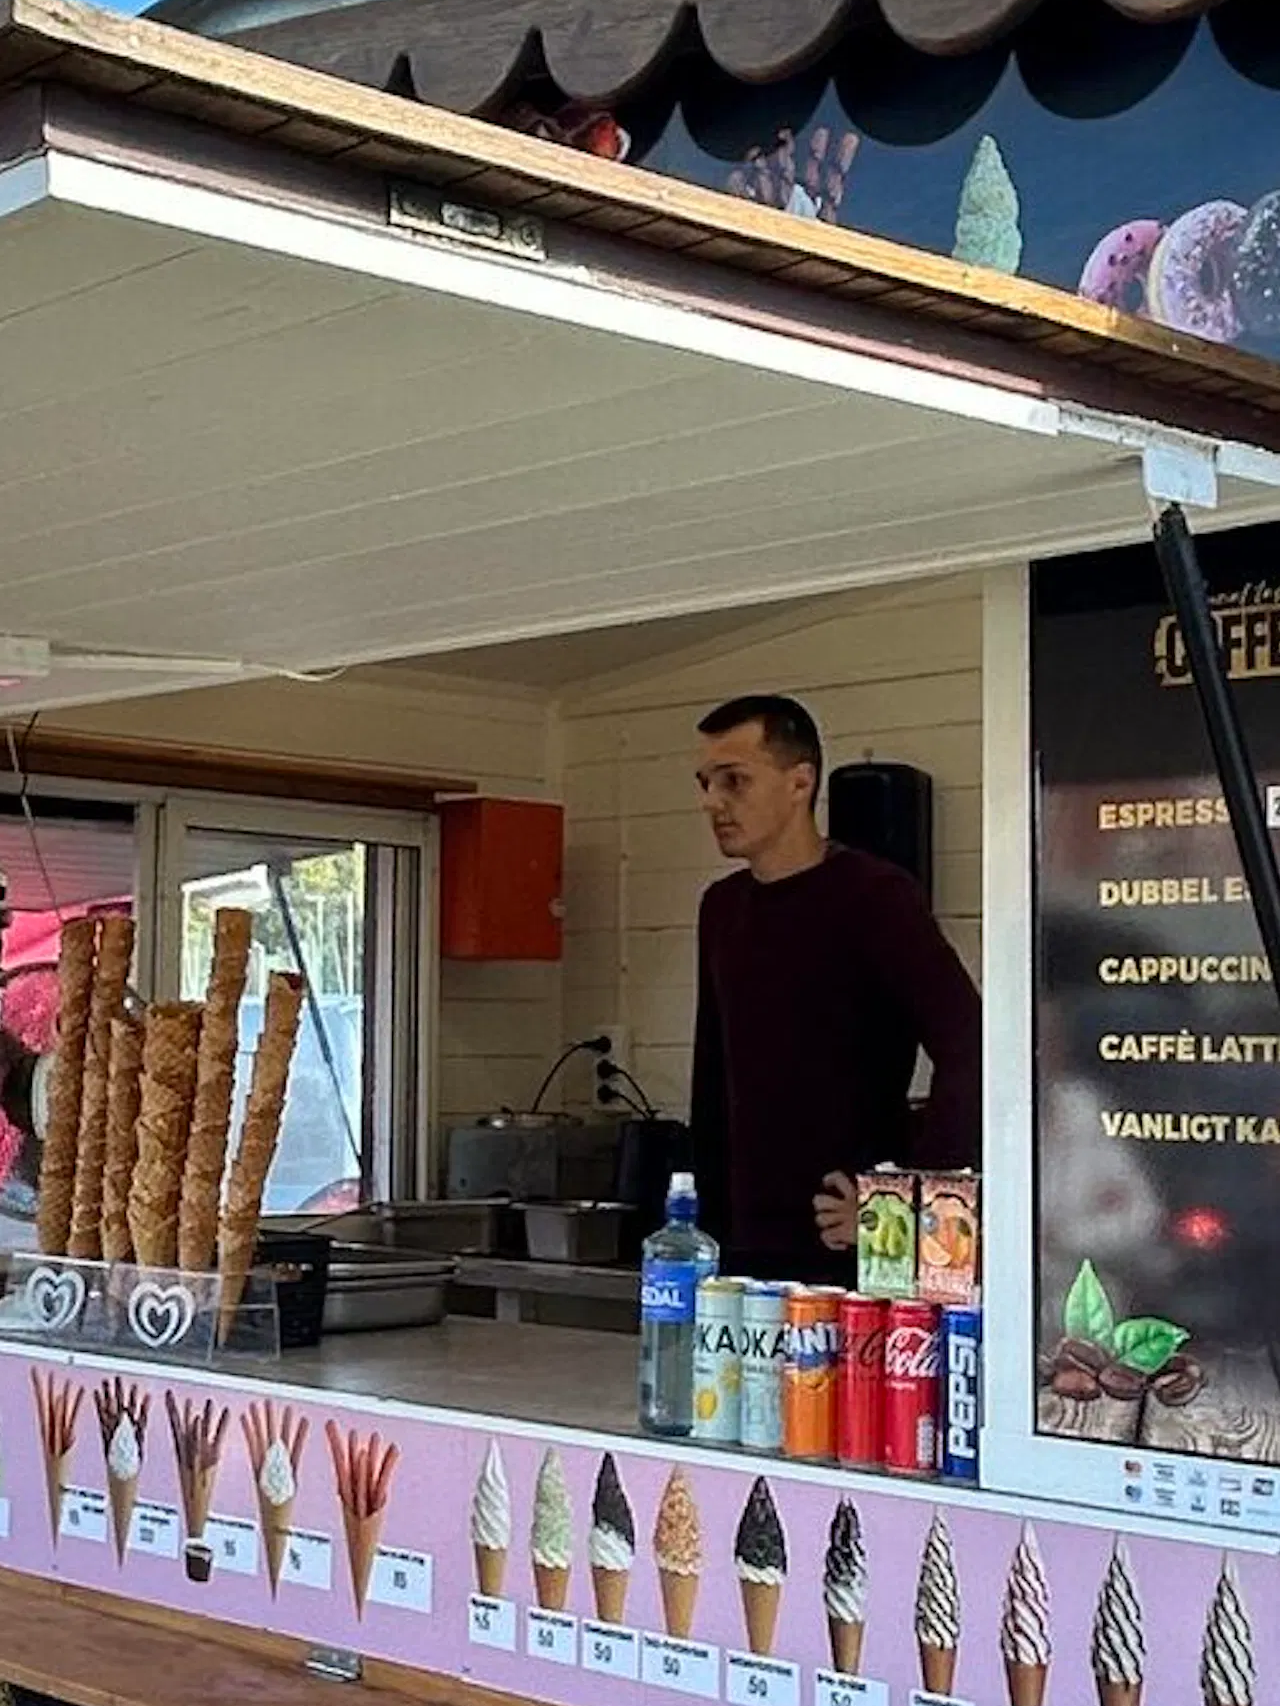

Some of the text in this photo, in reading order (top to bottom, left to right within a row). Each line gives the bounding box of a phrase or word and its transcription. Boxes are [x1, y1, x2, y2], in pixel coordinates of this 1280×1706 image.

[1098, 797, 1231, 830] ESPRESS
[1099, 878, 1218, 908] DUBBEL
[1098, 954, 1271, 985] CAPPUCCIN
[1098, 1029, 1197, 1062] CAFFÈ
[1100, 1110, 1231, 1143] VANLIGT
[949, 1333, 977, 1459] PEPSI
[748, 1675, 768, 1697] 50
